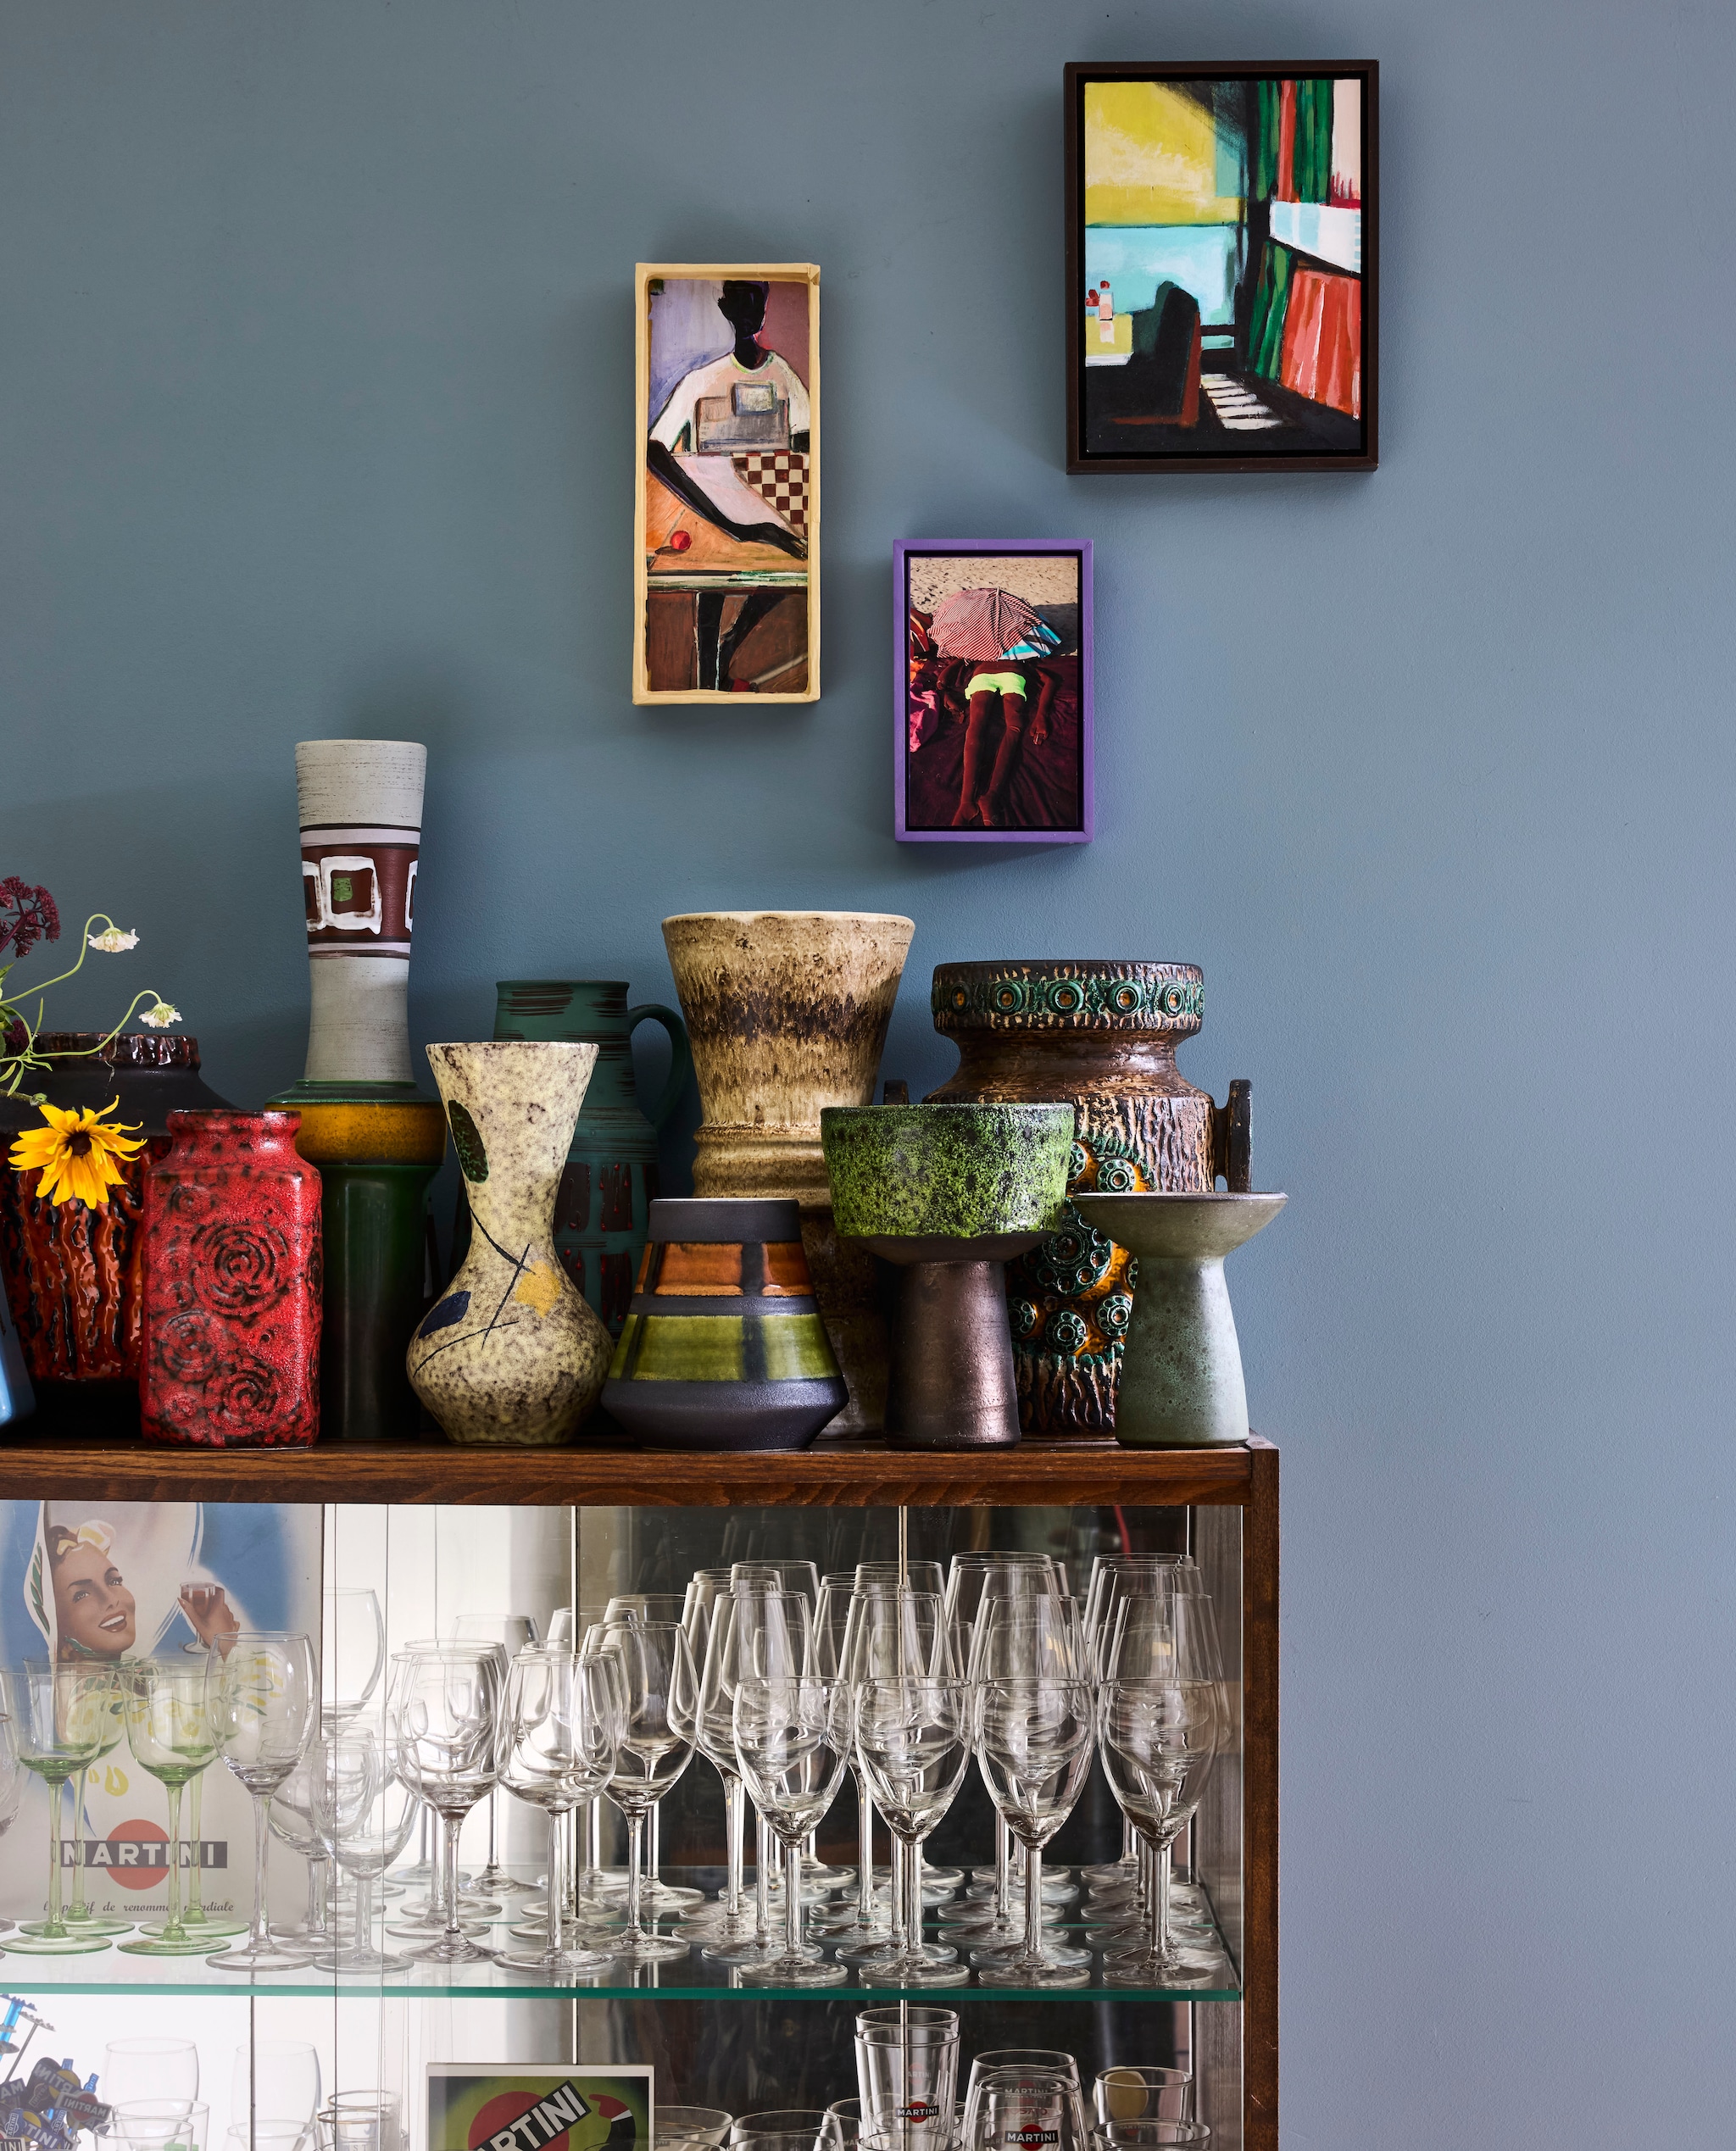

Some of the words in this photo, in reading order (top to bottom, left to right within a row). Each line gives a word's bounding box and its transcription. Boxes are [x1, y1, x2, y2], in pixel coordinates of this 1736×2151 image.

[103, 1901, 115, 1911] de
[123, 1904, 176, 1912] renomm
[183, 1901, 234, 1912] ndiale
[477, 2084, 587, 2151] RTINI
[897, 2107, 938, 2116] MARTINI
[8, 2113, 18, 2137] ARTINI
[53, 2109, 66, 2135] ARTINI
[24, 2120, 58, 2148] TINI
[1007, 2132, 1055, 2143] MARTINI
[0, 2141, 22, 2151] TINI
